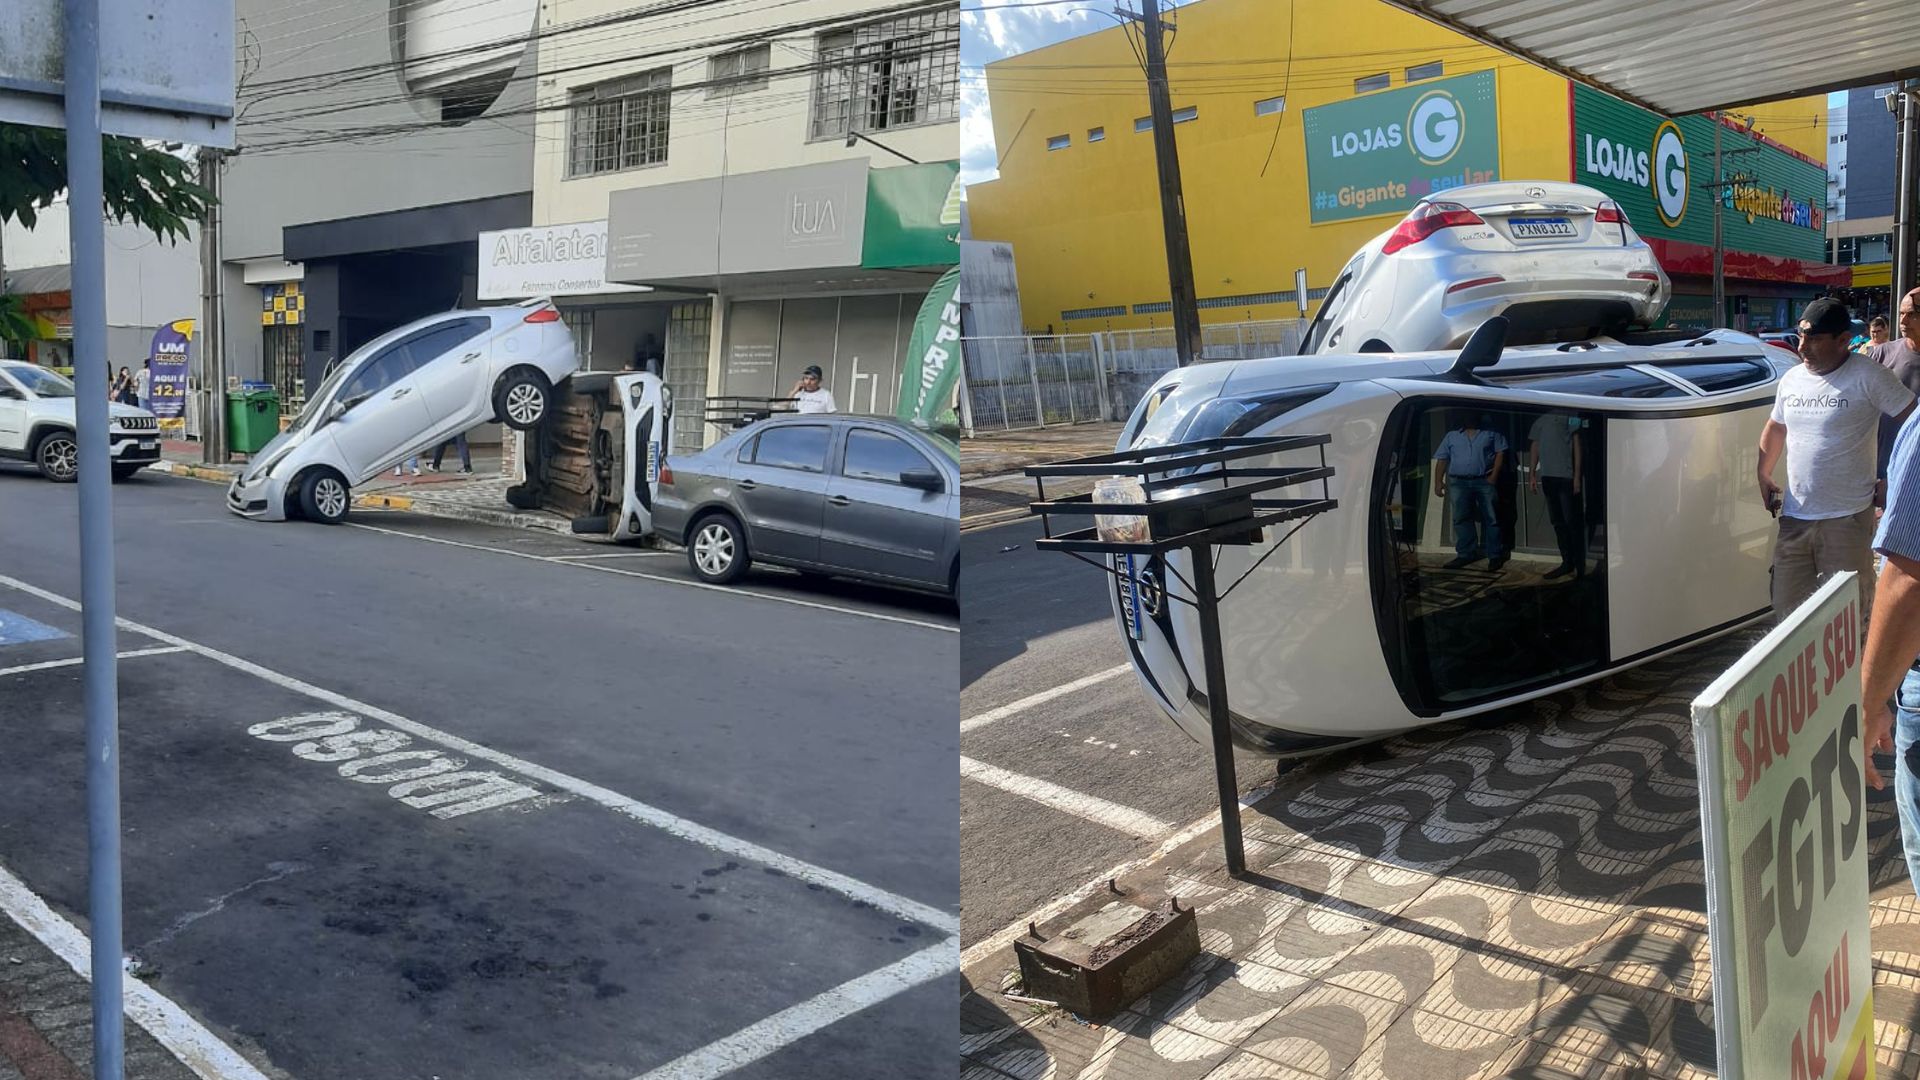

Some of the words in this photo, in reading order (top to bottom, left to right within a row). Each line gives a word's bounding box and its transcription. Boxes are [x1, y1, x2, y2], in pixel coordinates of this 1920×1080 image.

[1331, 122, 1403, 158] LOJAS
[1413, 97, 1459, 158] G
[1585, 133, 1650, 188] LOJAS
[1656, 132, 1687, 218] G
[1518, 223, 1572, 236] PXN8J12
[154, 375, 177, 383] AQUI
[158, 342, 185, 353] UM
[1734, 639, 1819, 803] SAQUE
[1823, 599, 1857, 697] SEU
[1742, 703, 1862, 1036] FGTS
[1791, 929, 1851, 1080] AQUI
